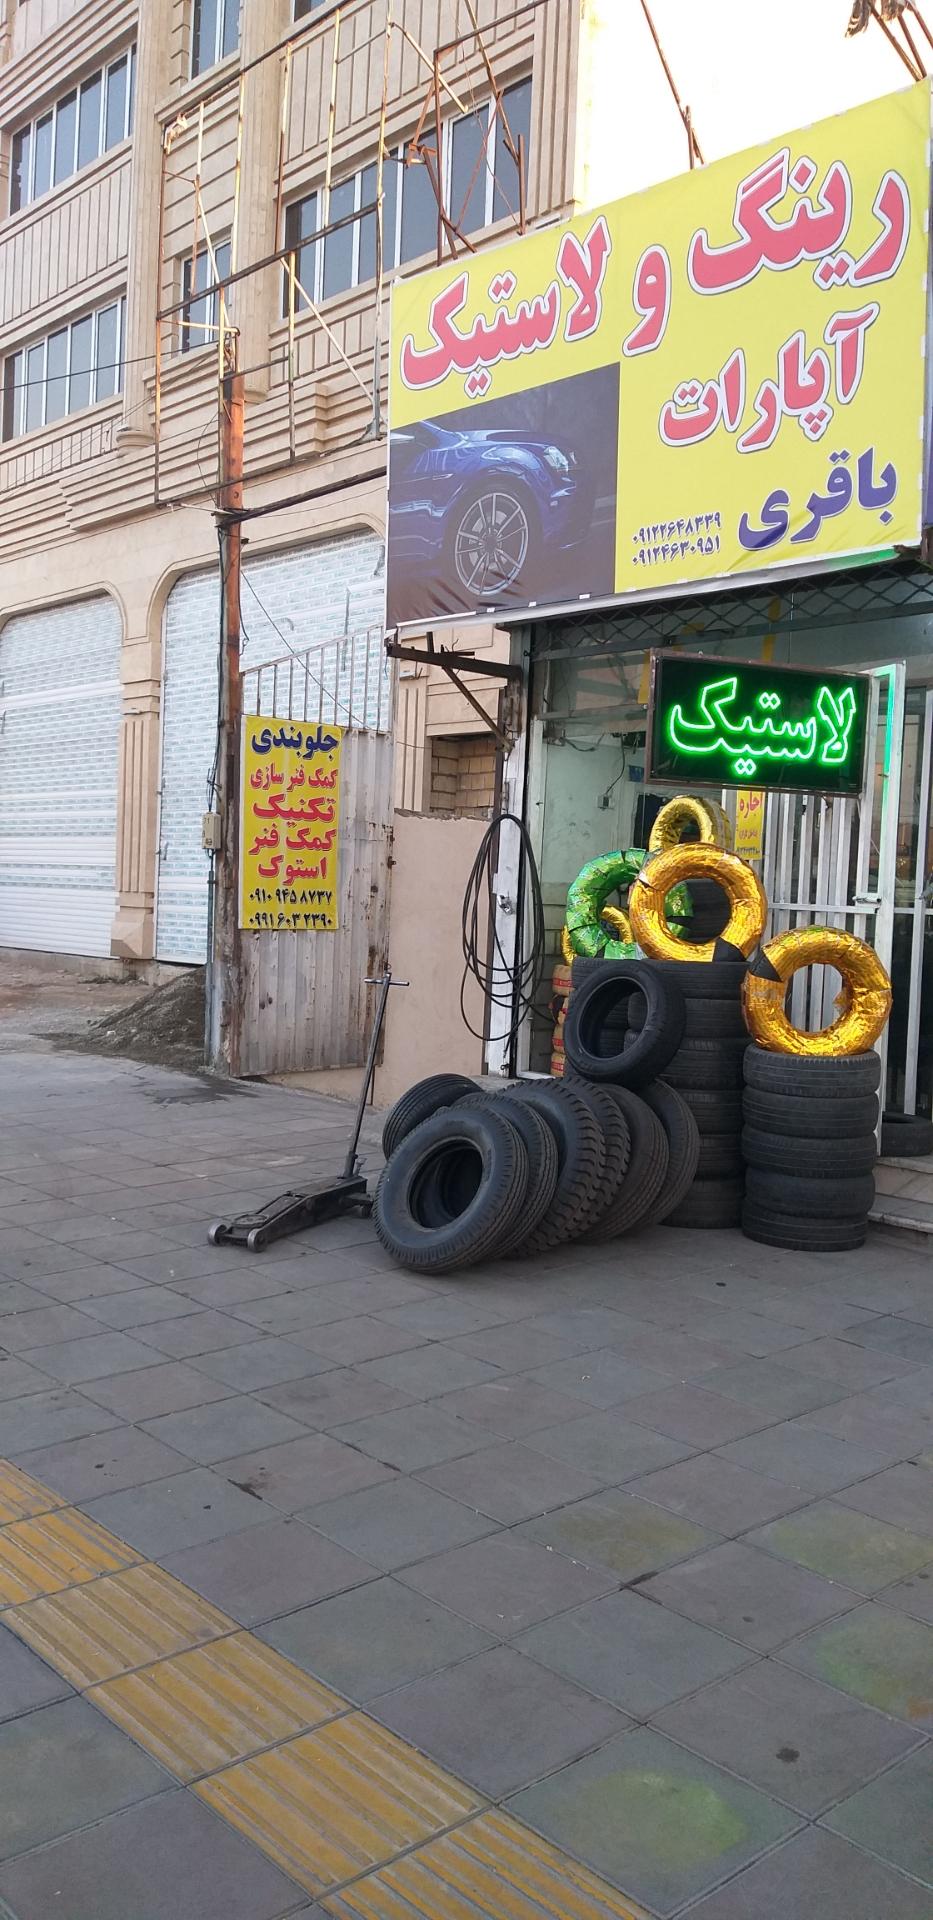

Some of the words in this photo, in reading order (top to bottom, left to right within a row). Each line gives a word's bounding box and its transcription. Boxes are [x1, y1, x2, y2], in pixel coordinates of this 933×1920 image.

[687, 147, 911, 295] رینگ
[400, 215, 612, 398] لاستیک
[623, 244, 672, 357] و
[658, 302, 880, 454] آپارات
[737, 447, 899, 551] باقری
[632, 510, 721, 545] ۰۹۱۲۲۶۴۸۳۳۹
[632, 533, 720, 567] ۰۹۱۲۴۶۳۰۹۵۱
[251, 725, 339, 761] جلوبندی
[670, 676, 857, 776] لاستیک
[250, 761, 285, 791] سازی
[286, 763, 306, 792] فنر
[308, 767, 338, 789] کمک
[252, 793, 337, 828] تکنیک
[248, 822, 280, 855] فنر
[286, 827, 337, 851] کمک
[258, 854, 328, 886] استوک
[249, 887, 272, 904] ۰۹۱۰
[275, 887, 298, 905] ۹۴۵
[300, 889, 333, 905] ۸۷۳۷
[249, 911, 275, 928] ۰۹۹۱
[277, 911, 301, 928] ۶۰۳
